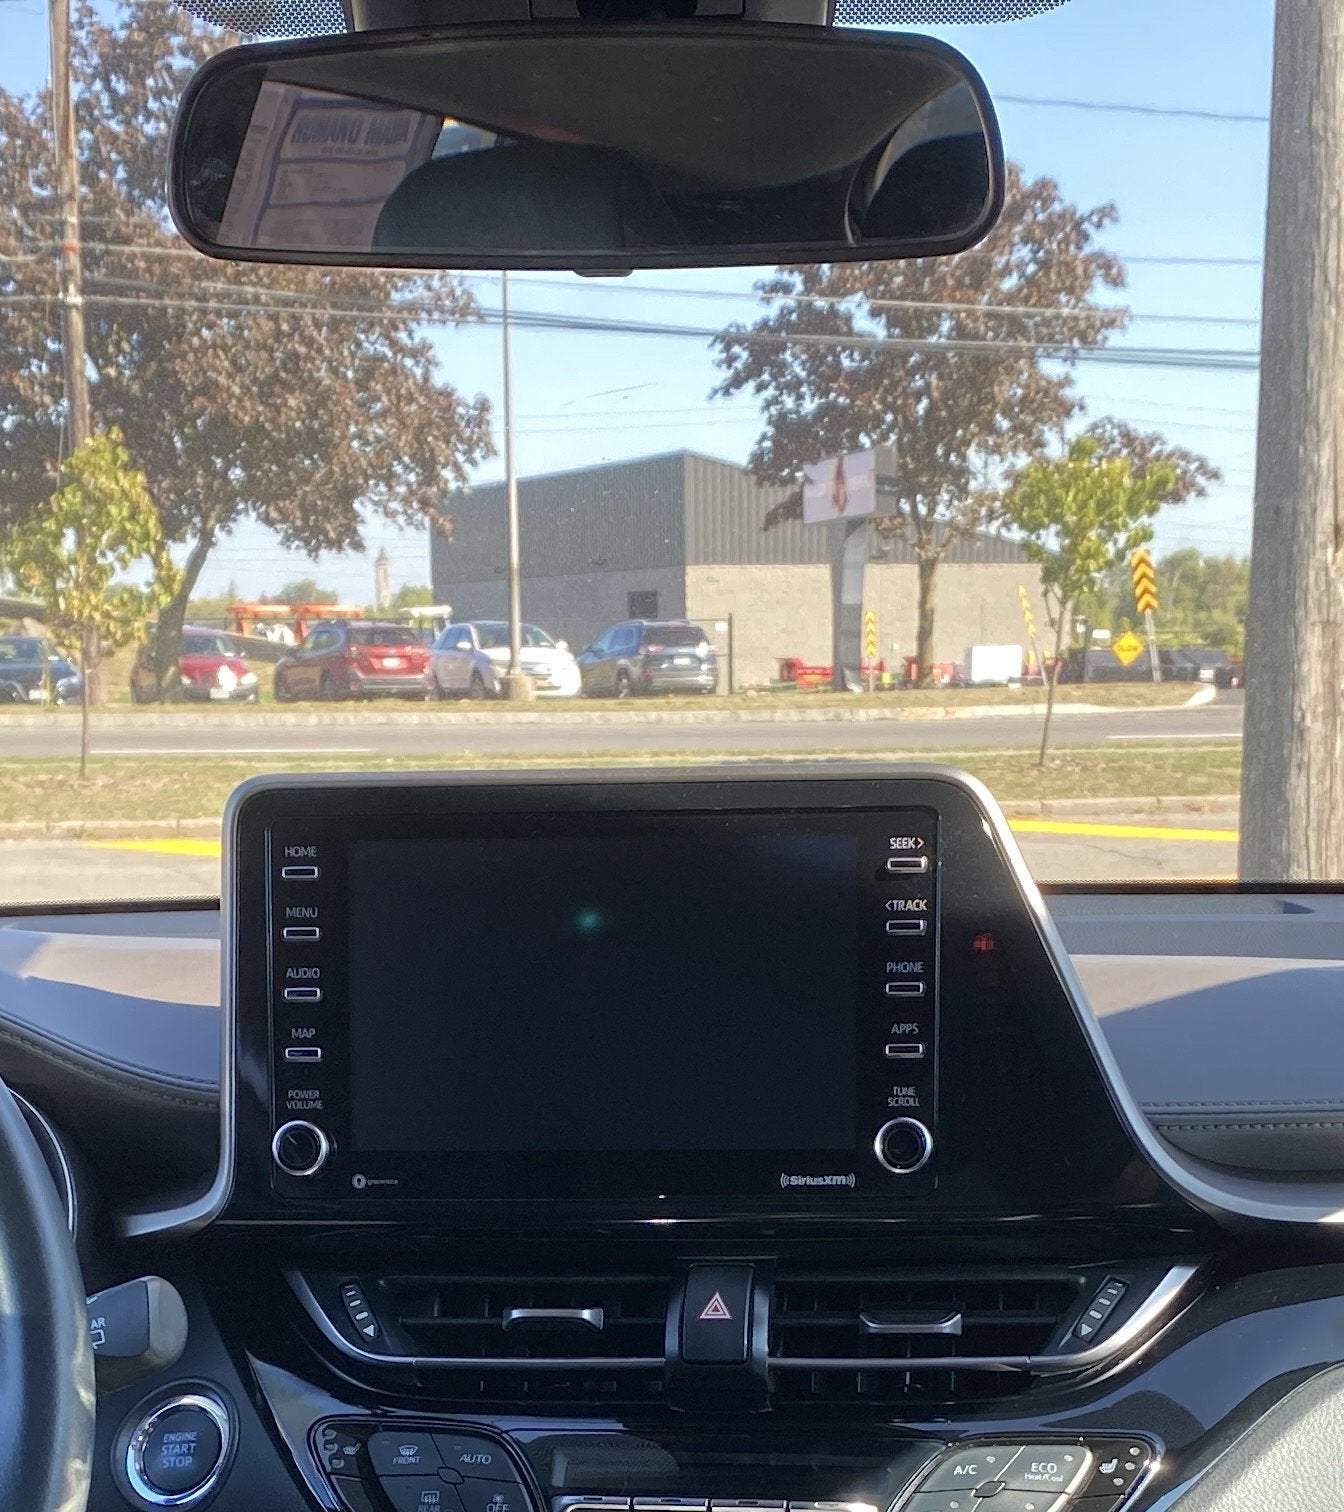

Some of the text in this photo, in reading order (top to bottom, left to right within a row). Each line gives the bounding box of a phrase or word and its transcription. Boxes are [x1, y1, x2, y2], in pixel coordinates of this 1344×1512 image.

[284, 846, 317, 857] HOME
[285, 906, 318, 918] MENU
[886, 961, 924, 973] PHONE
[286, 967, 321, 979] AUDIO
[291, 1028, 316, 1039] MAP
[891, 1022, 920, 1034] APPS
[288, 1089, 320, 1099] POWER
[892, 1086, 917, 1096] TUNE
[285, 1100, 323, 1110] VOLUME
[887, 1096, 921, 1107] SCROLL
[163, 1431, 198, 1442] ENGINE
[161, 1443, 197, 1456] START
[162, 1456, 193, 1468] STOP
[392, 1455, 422, 1465] FRONT
[459, 1453, 492, 1465] AUTO
[953, 1464, 978, 1475] A/C
[1030, 1462, 1058, 1474] ECO
